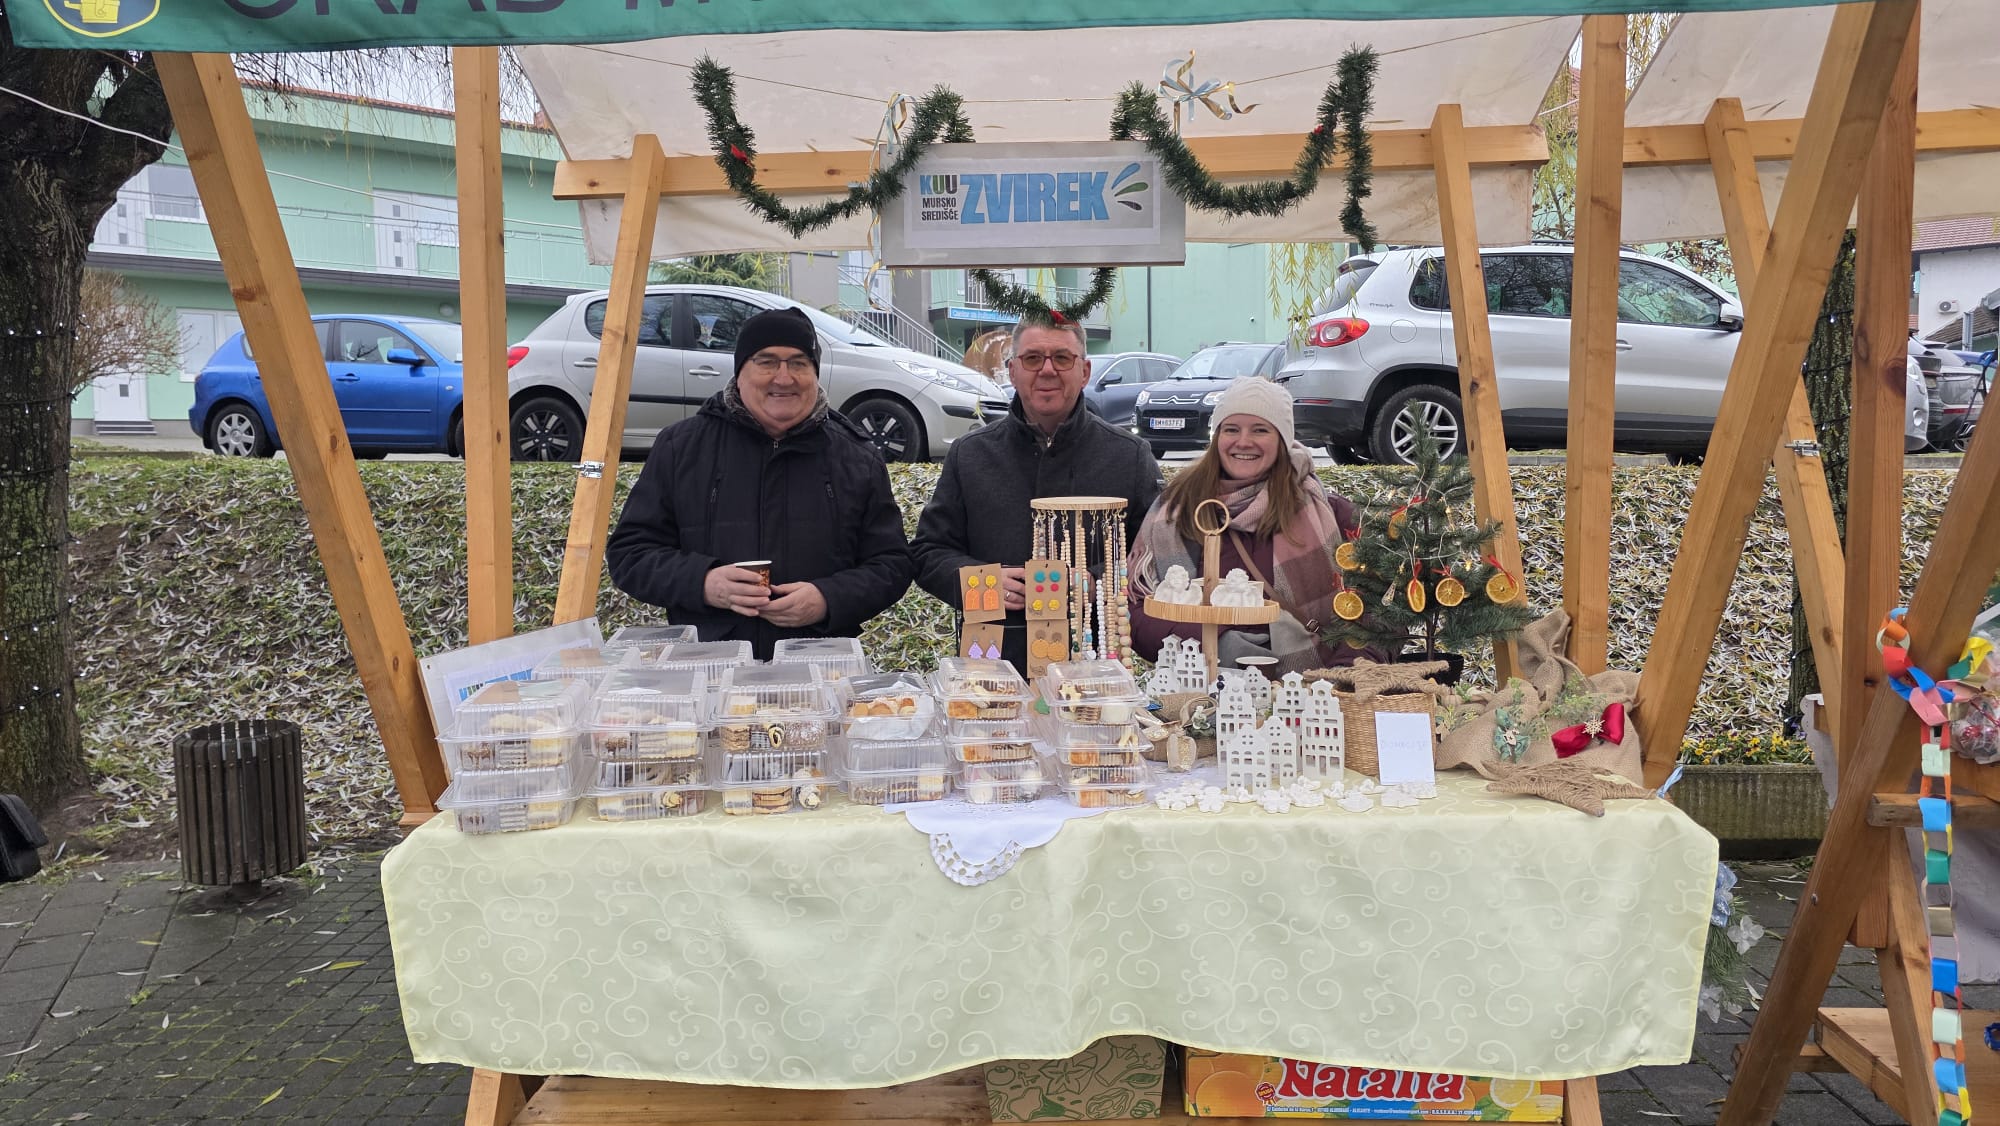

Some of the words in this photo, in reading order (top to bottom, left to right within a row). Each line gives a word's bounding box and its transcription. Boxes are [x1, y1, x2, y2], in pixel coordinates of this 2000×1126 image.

[920, 174, 958, 195] KUU
[960, 172, 1110, 224] ZVIREK
[922, 197, 957, 208] MURSKO
